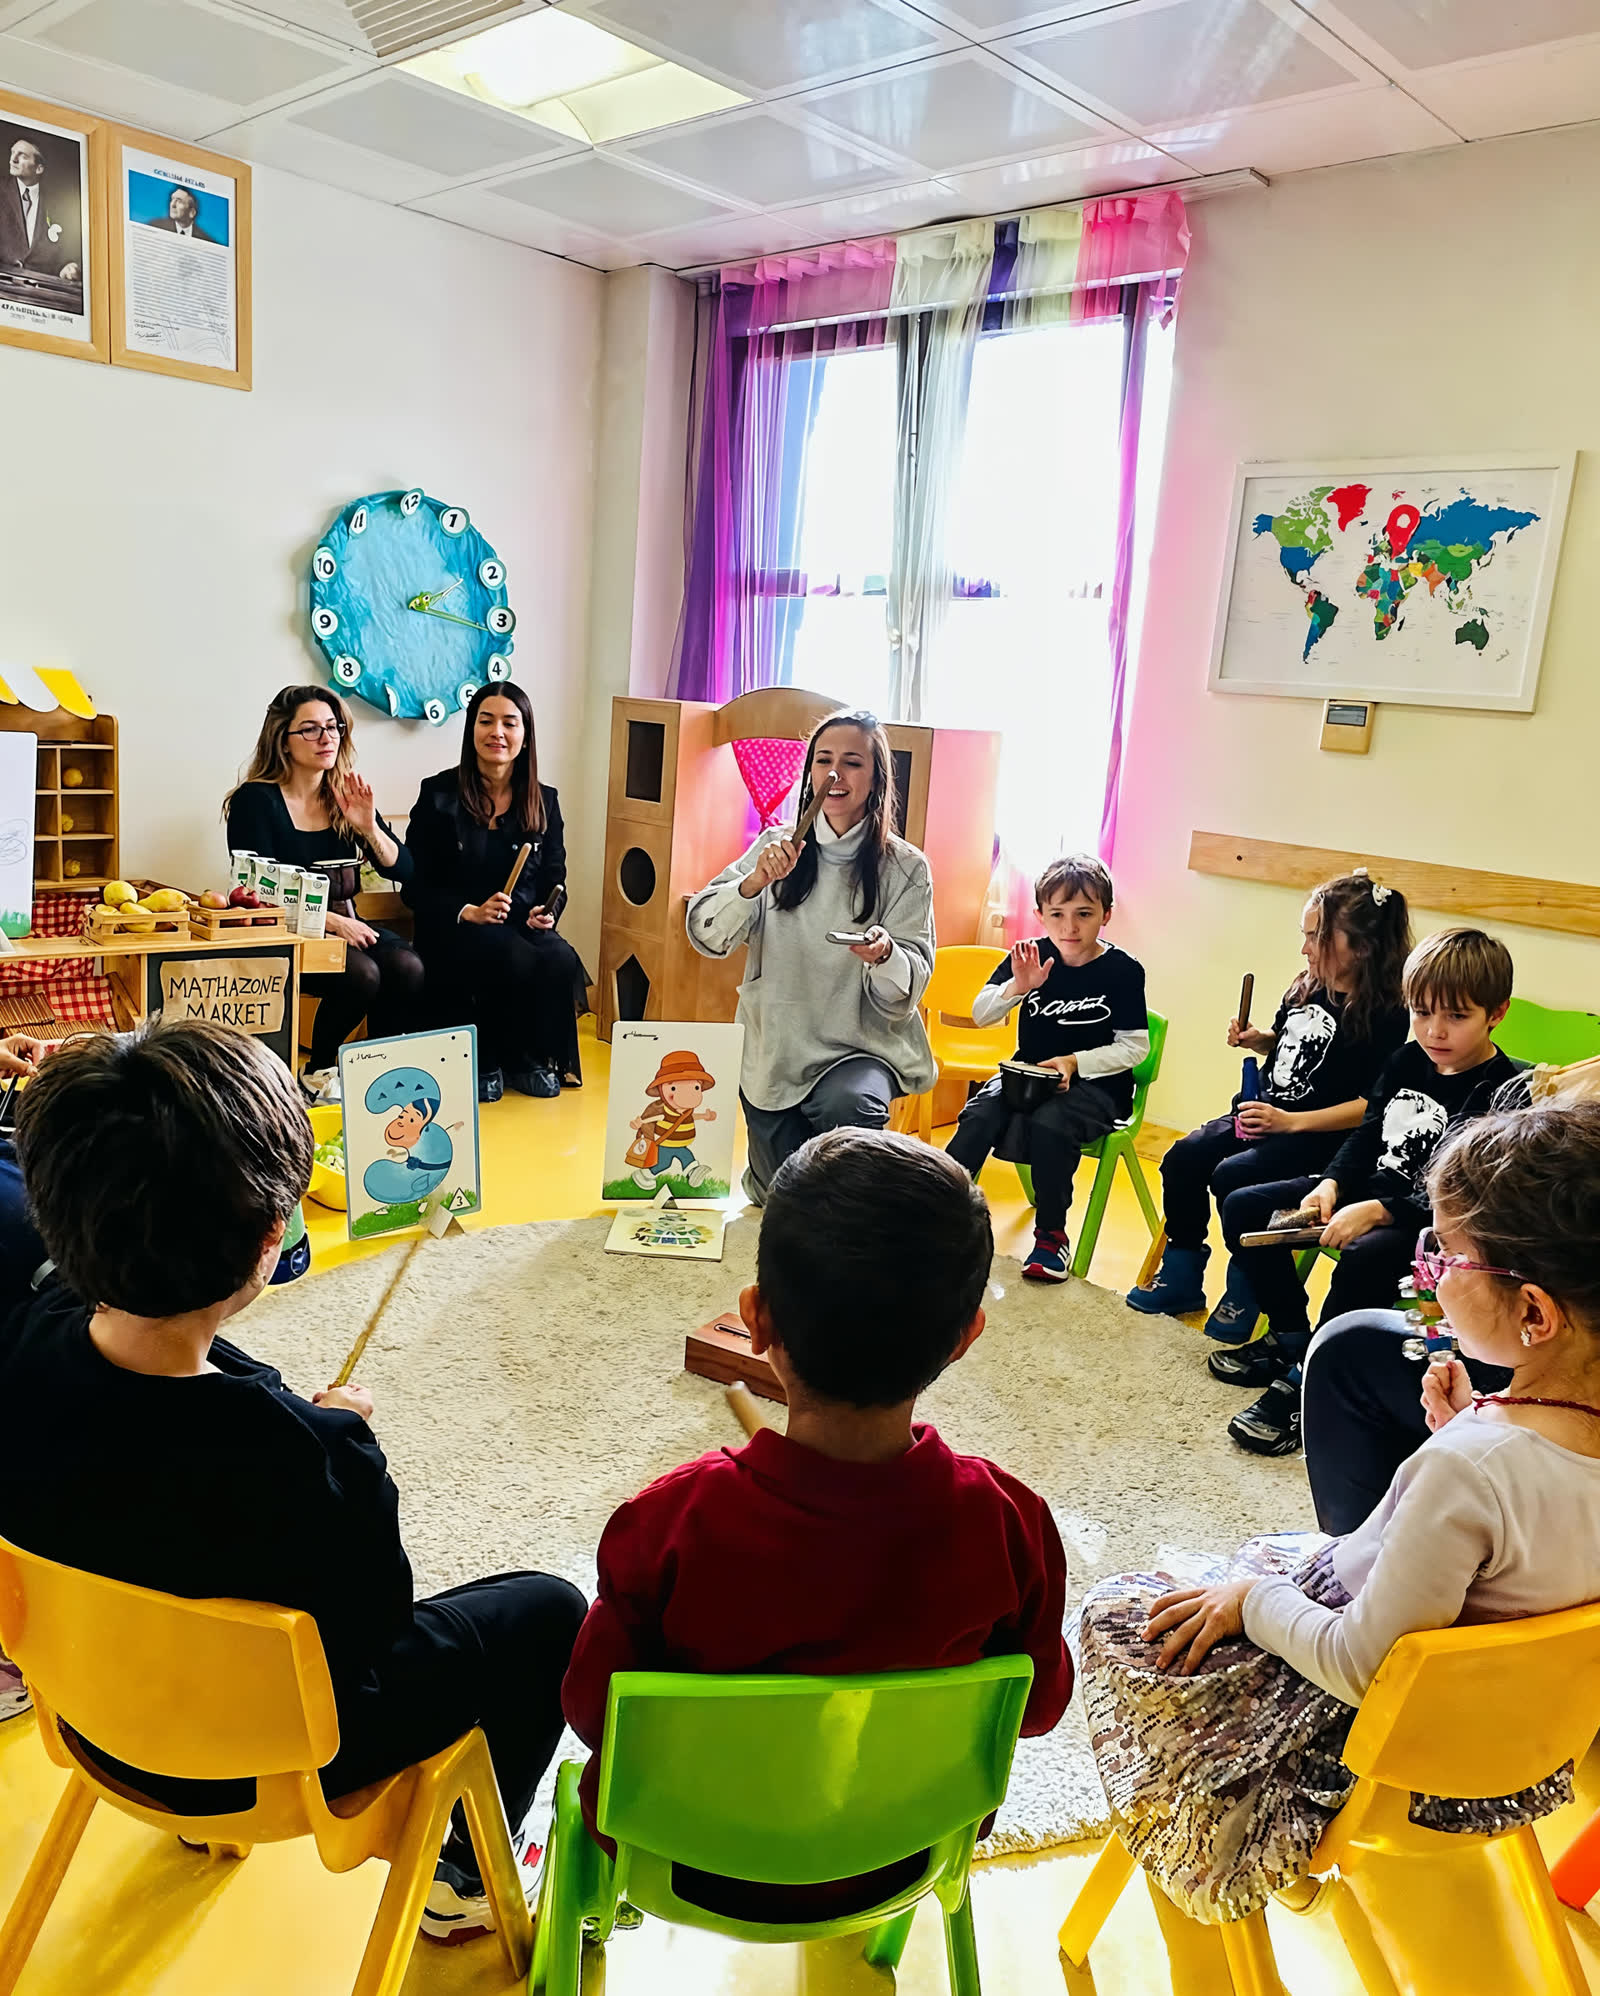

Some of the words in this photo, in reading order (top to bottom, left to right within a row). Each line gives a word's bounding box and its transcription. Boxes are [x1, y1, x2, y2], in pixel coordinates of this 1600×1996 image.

[404, 494, 419, 511] 12
[353, 512, 364, 529] 11
[449, 513, 458, 528] 1
[317, 557, 334, 575] 10
[487, 565, 498, 580] 2
[319, 614, 332, 629] 9
[496, 612, 507, 628] 3
[342, 662, 354, 677] 8
[491, 661, 502, 676] 4
[429, 704, 440, 720] 6
[168, 975, 283, 999] MATHAZONE
[186, 1001, 271, 1026] MARKET
[456, 1195, 464, 1207] 3
